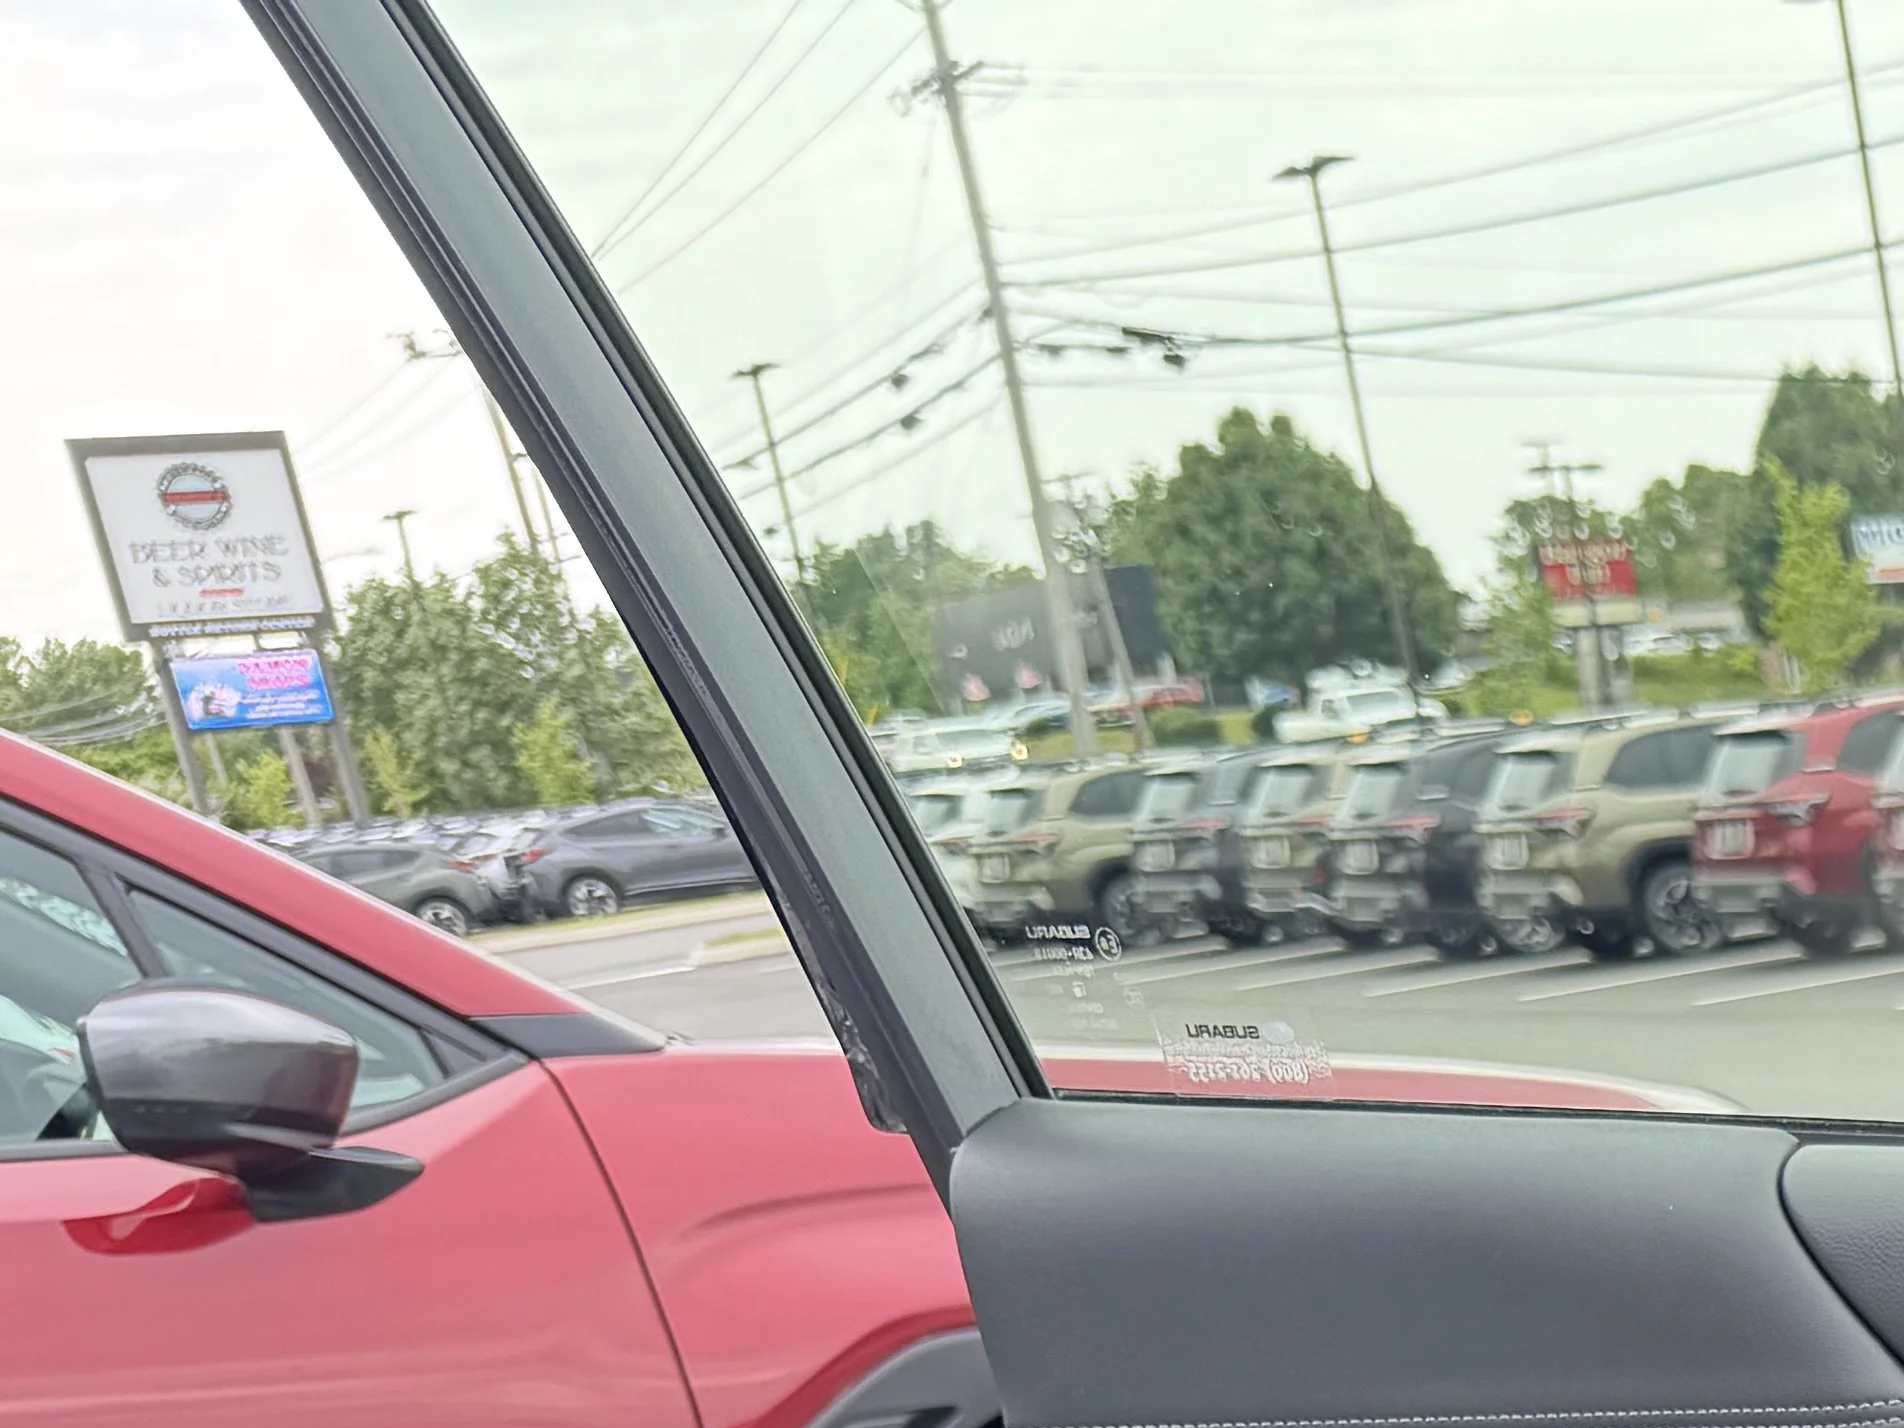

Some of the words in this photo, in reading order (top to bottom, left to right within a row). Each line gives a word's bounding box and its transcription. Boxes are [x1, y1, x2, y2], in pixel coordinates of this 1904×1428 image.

[128, 539, 206, 564] BEER
[214, 534, 291, 558] WINE
[177, 561, 282, 587] SPIRITS
